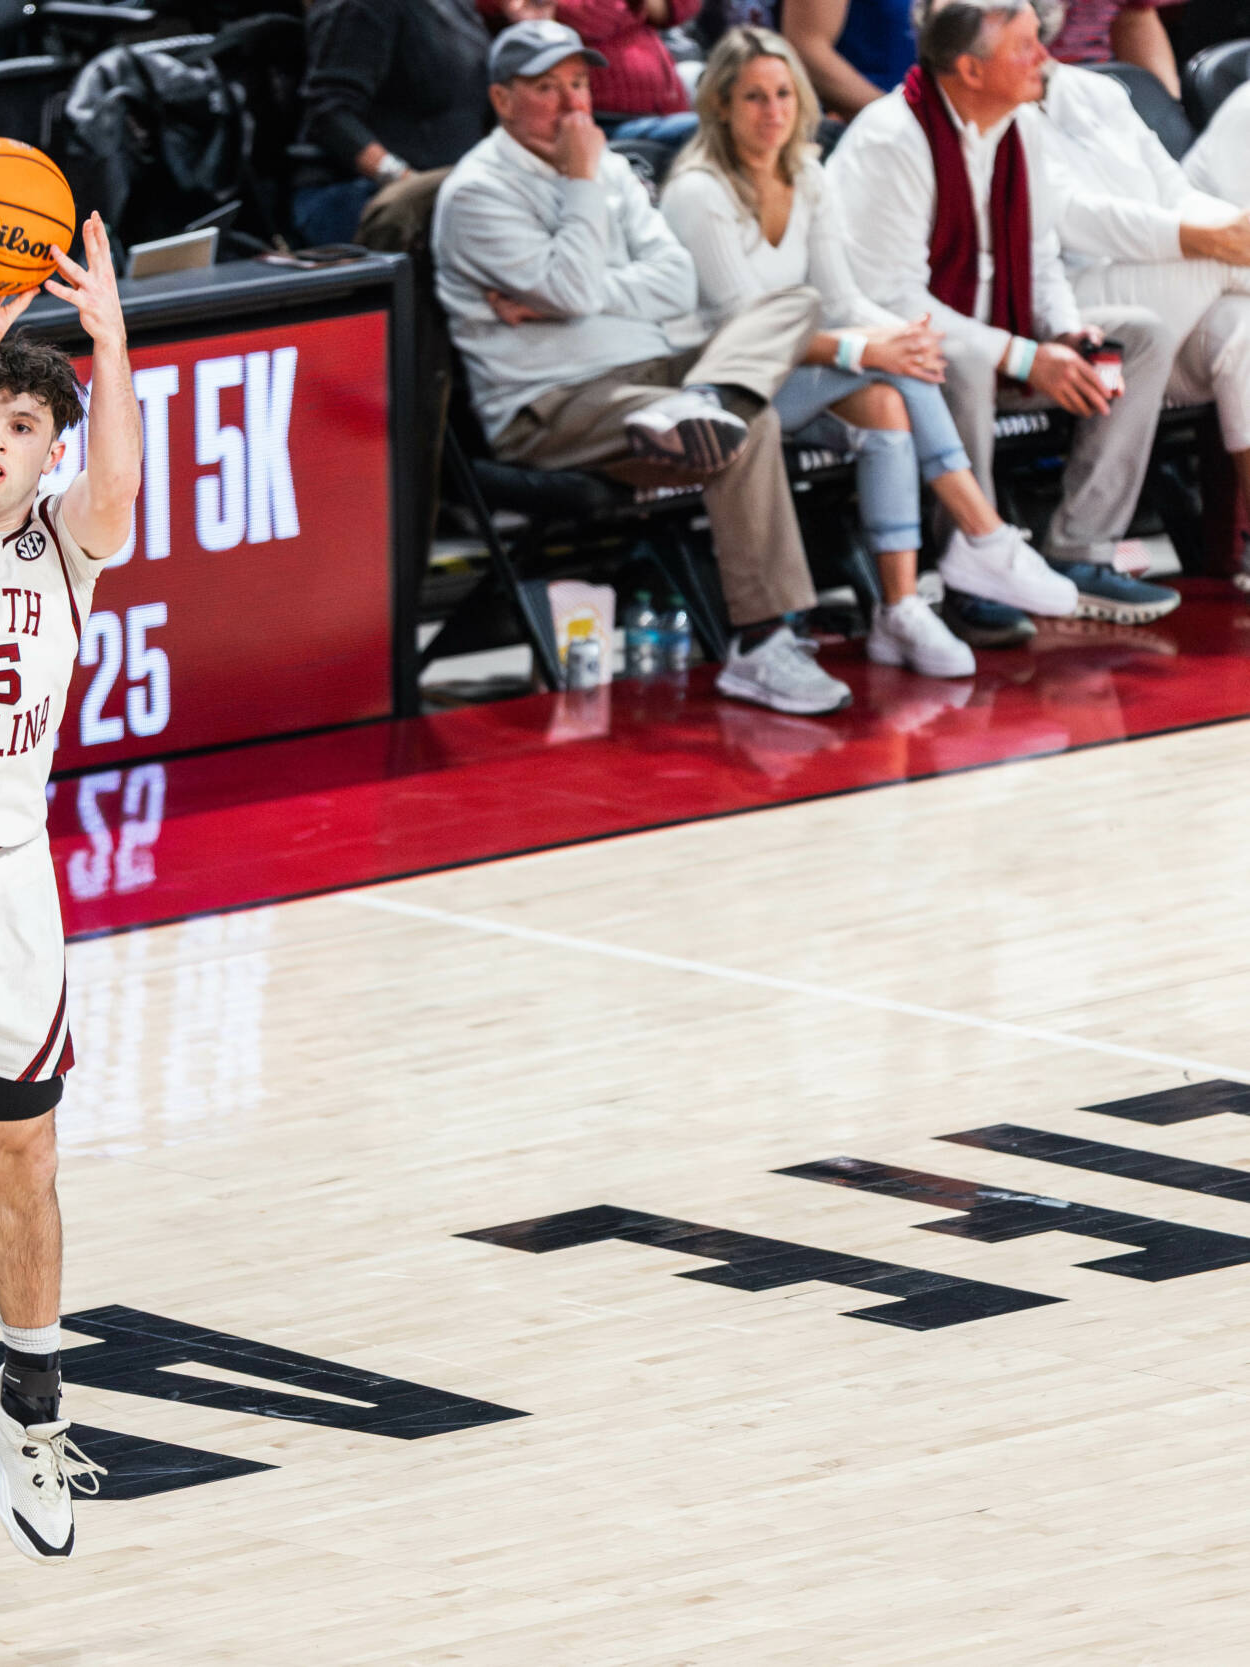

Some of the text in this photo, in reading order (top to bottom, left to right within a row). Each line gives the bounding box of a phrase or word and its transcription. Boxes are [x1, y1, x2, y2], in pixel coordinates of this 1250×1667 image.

[194, 346, 301, 553] 5K
[17, 531, 46, 559] SEC
[78, 602, 171, 745] 25
